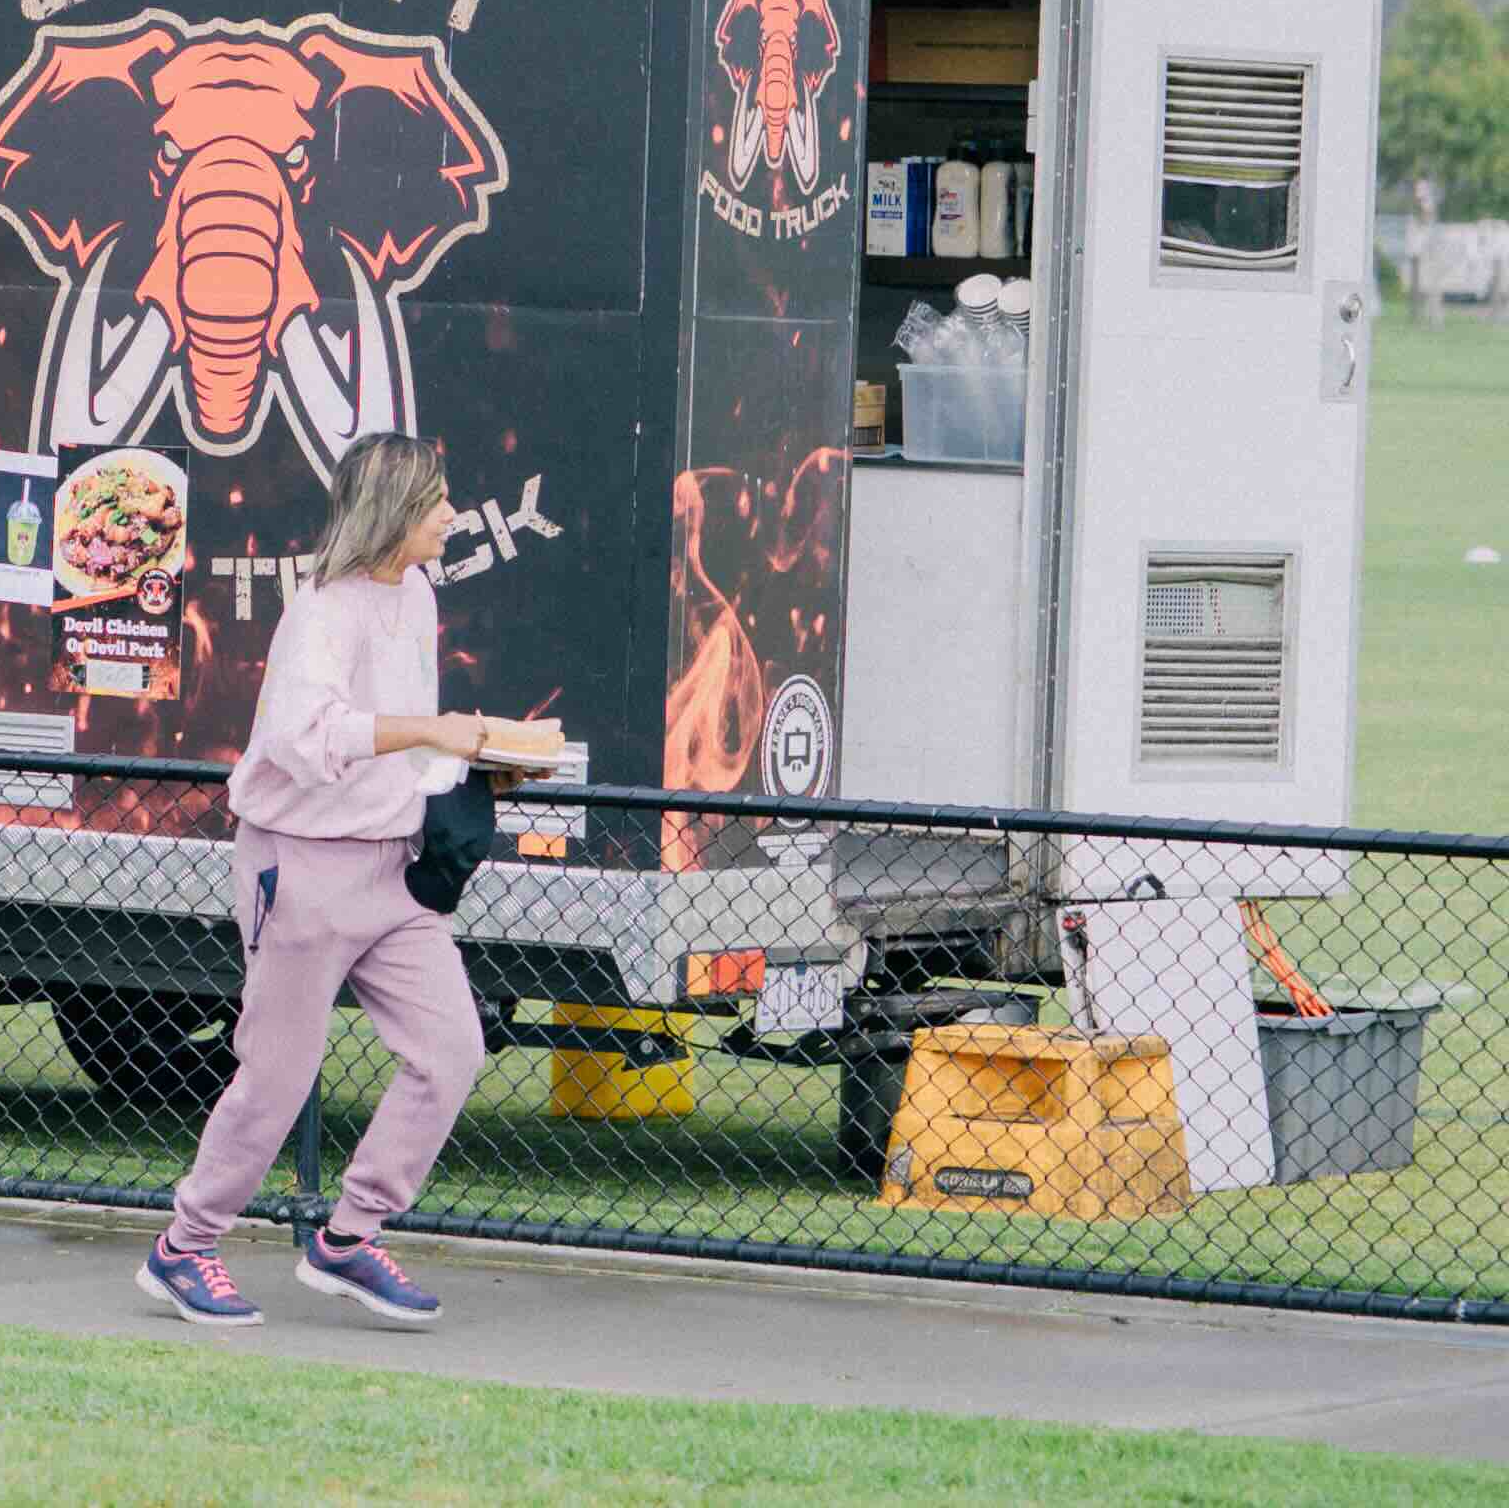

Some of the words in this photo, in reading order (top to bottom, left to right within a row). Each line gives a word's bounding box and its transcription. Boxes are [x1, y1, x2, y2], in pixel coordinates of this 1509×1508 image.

[699, 170, 762, 238] FOOD
[769, 172, 850, 240] TRUCK
[211, 473, 565, 621] TCK
[64, 616, 103, 634] Devil
[105, 618, 168, 638] Chicken
[66, 637, 85, 654] Or
[88, 638, 126, 657] Devil
[128, 642, 166, 659] Pork
